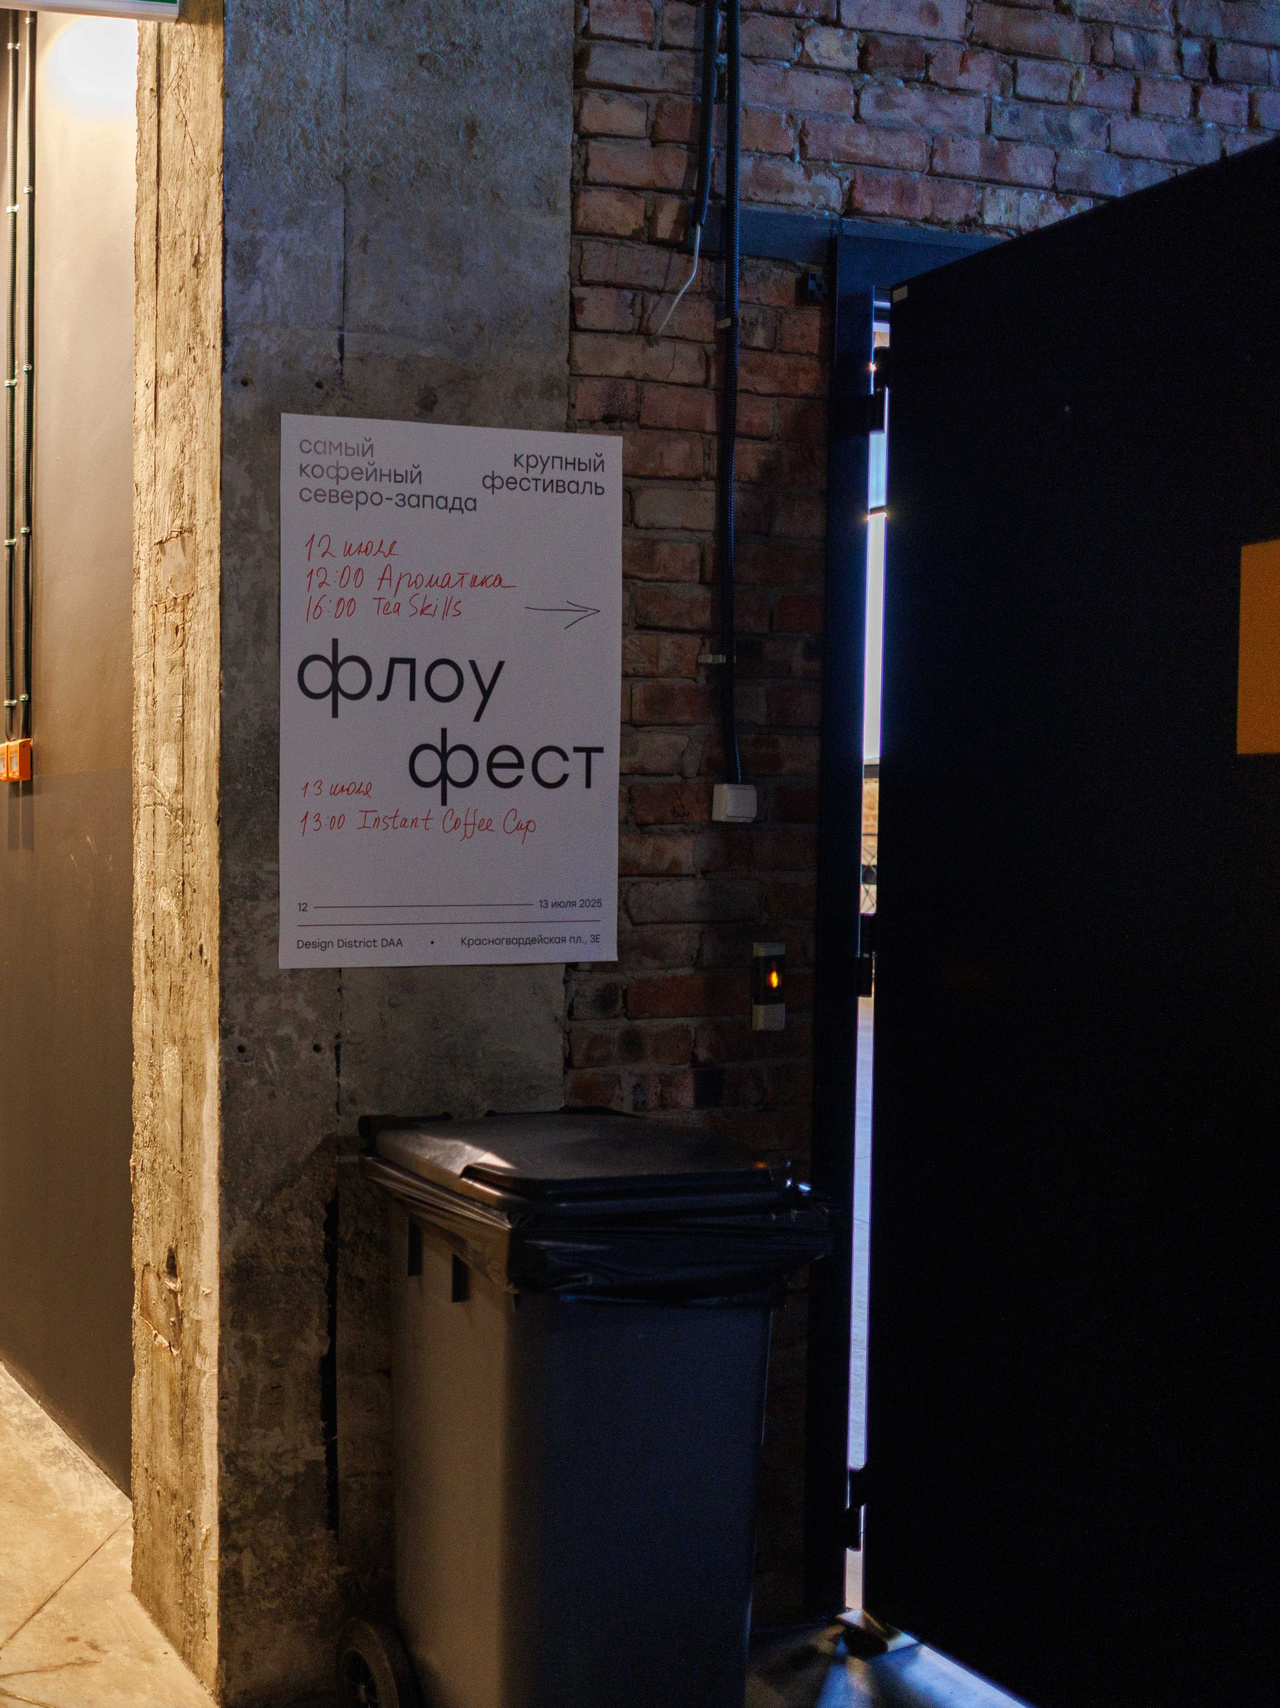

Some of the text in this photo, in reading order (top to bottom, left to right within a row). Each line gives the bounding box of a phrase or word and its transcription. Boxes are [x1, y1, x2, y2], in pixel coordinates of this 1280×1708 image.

[299, 437, 604, 474] самый крупный
[300, 462, 605, 496] кофейный фестиваль
[299, 486, 477, 514] северо-запада
[305, 534, 335, 561] 12
[307, 564, 517, 598] 12:00 Ароматика
[306, 594, 356, 621] 16:00
[298, 638, 505, 722] флоу
[409, 728, 604, 806] фест
[301, 779, 324, 798] 13
[300, 808, 536, 844] 13:00 Instant Coffee Cup
[297, 897, 603, 913] 12 13 июля 2025
[296, 937, 404, 952] Design District DAA
[460, 934, 567, 949] Красногвардейская
